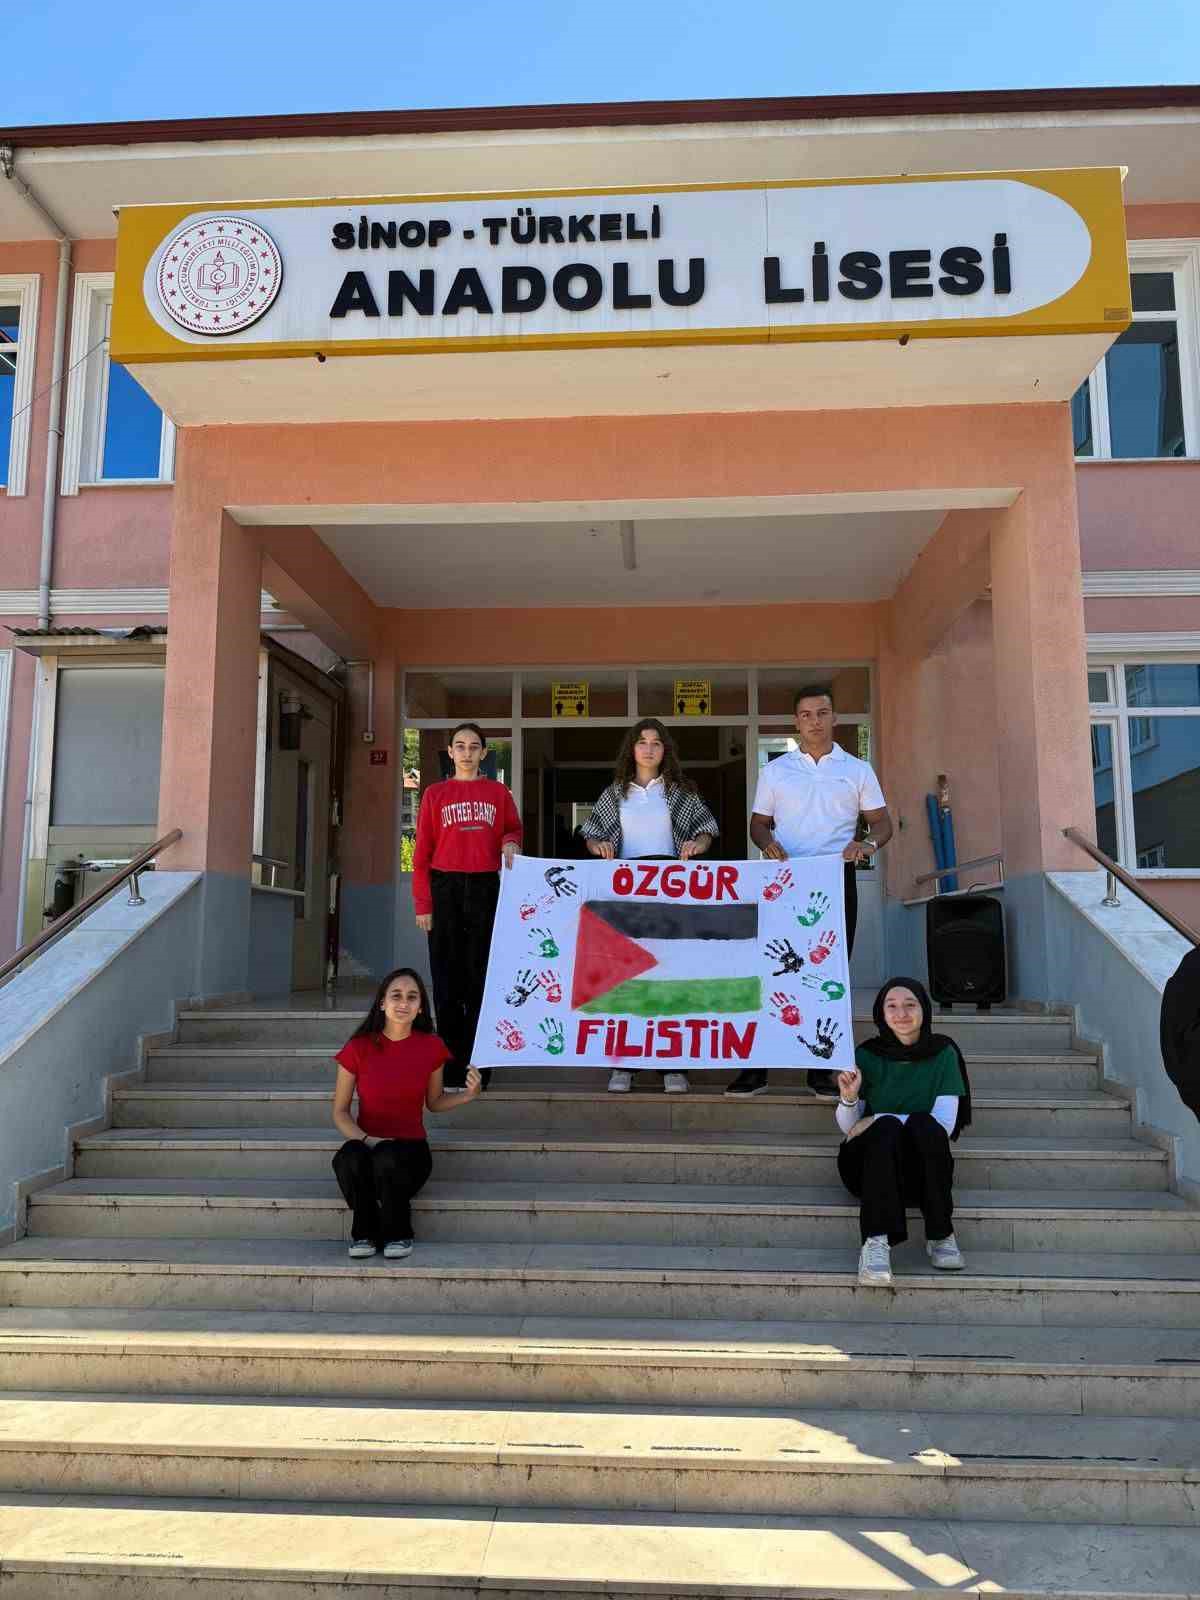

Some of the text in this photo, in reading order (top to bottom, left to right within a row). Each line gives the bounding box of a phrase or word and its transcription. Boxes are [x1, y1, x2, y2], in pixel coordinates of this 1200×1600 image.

[331, 215, 452, 250] SİNOP
[482, 203, 661, 246] TÜRKELİ
[329, 233, 1012, 319] ANADOLU LİSESİ
[612, 864, 739, 901] ÖZGÜR
[575, 1018, 758, 1060] FİLİSTİN
